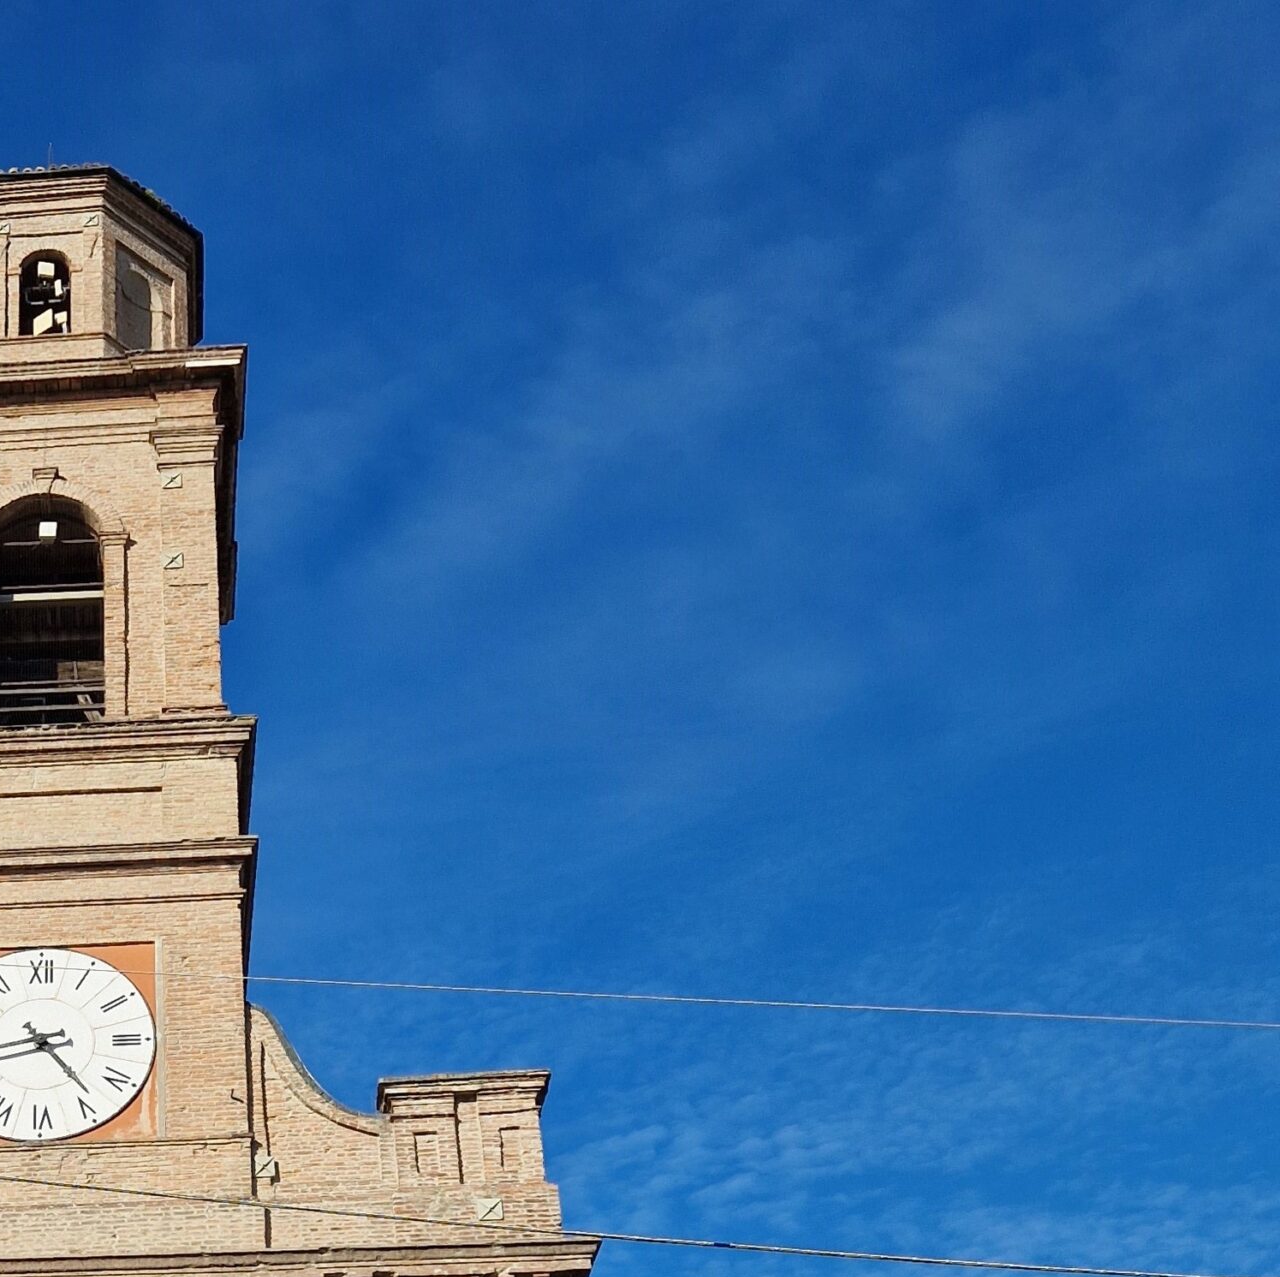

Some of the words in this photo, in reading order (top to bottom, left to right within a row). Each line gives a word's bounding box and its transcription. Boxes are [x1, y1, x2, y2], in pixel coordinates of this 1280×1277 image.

[29, 959, 54, 984] XII
[75, 968, 91, 990] I
[100, 995, 128, 1013] II
[112, 1033, 142, 1046] III
[102, 1066, 131, 1092] IV
[33, 1104, 53, 1130] VI
[77, 1096, 97, 1119] V
